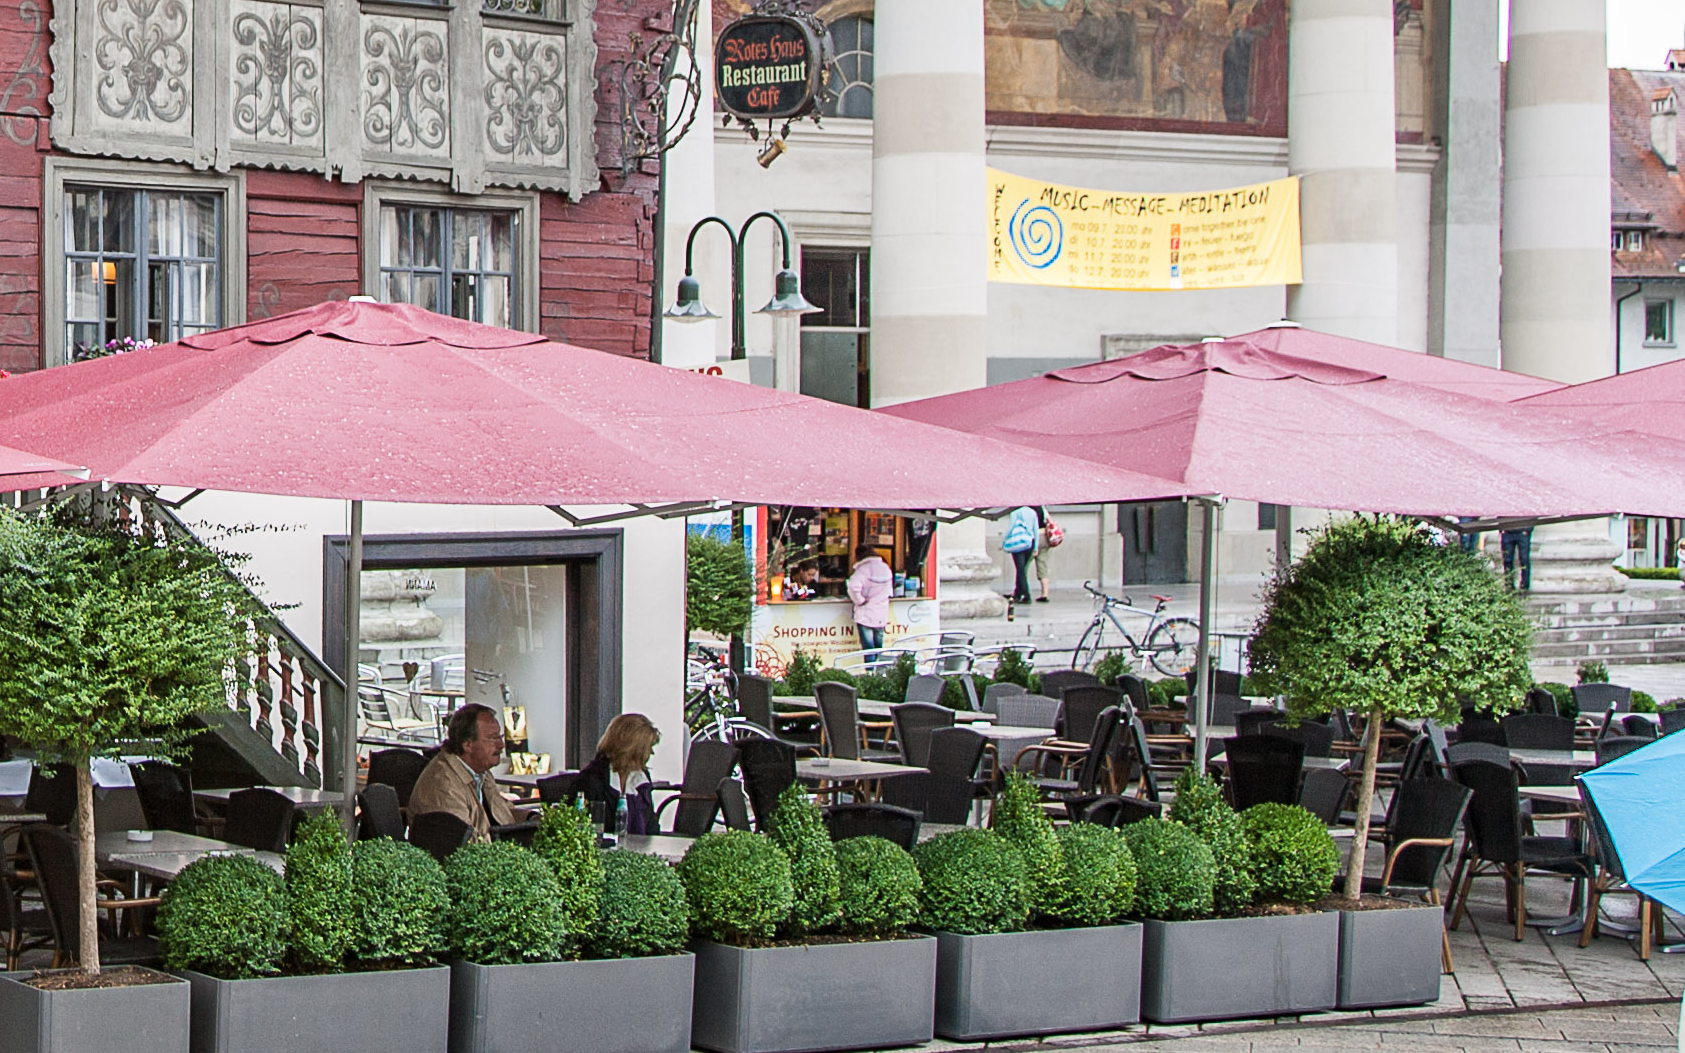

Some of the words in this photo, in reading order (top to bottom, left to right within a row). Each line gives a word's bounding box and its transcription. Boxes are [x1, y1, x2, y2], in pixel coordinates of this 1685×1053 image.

[724, 38, 768, 63] Rotes
[770, 34, 805, 63] Haus
[722, 60, 807, 87] Restaurant
[1040, 187, 1089, 211] MUSIC
[1102, 196, 1166, 218] MESSAGE
[1179, 186, 1270, 216] MEDITATION
